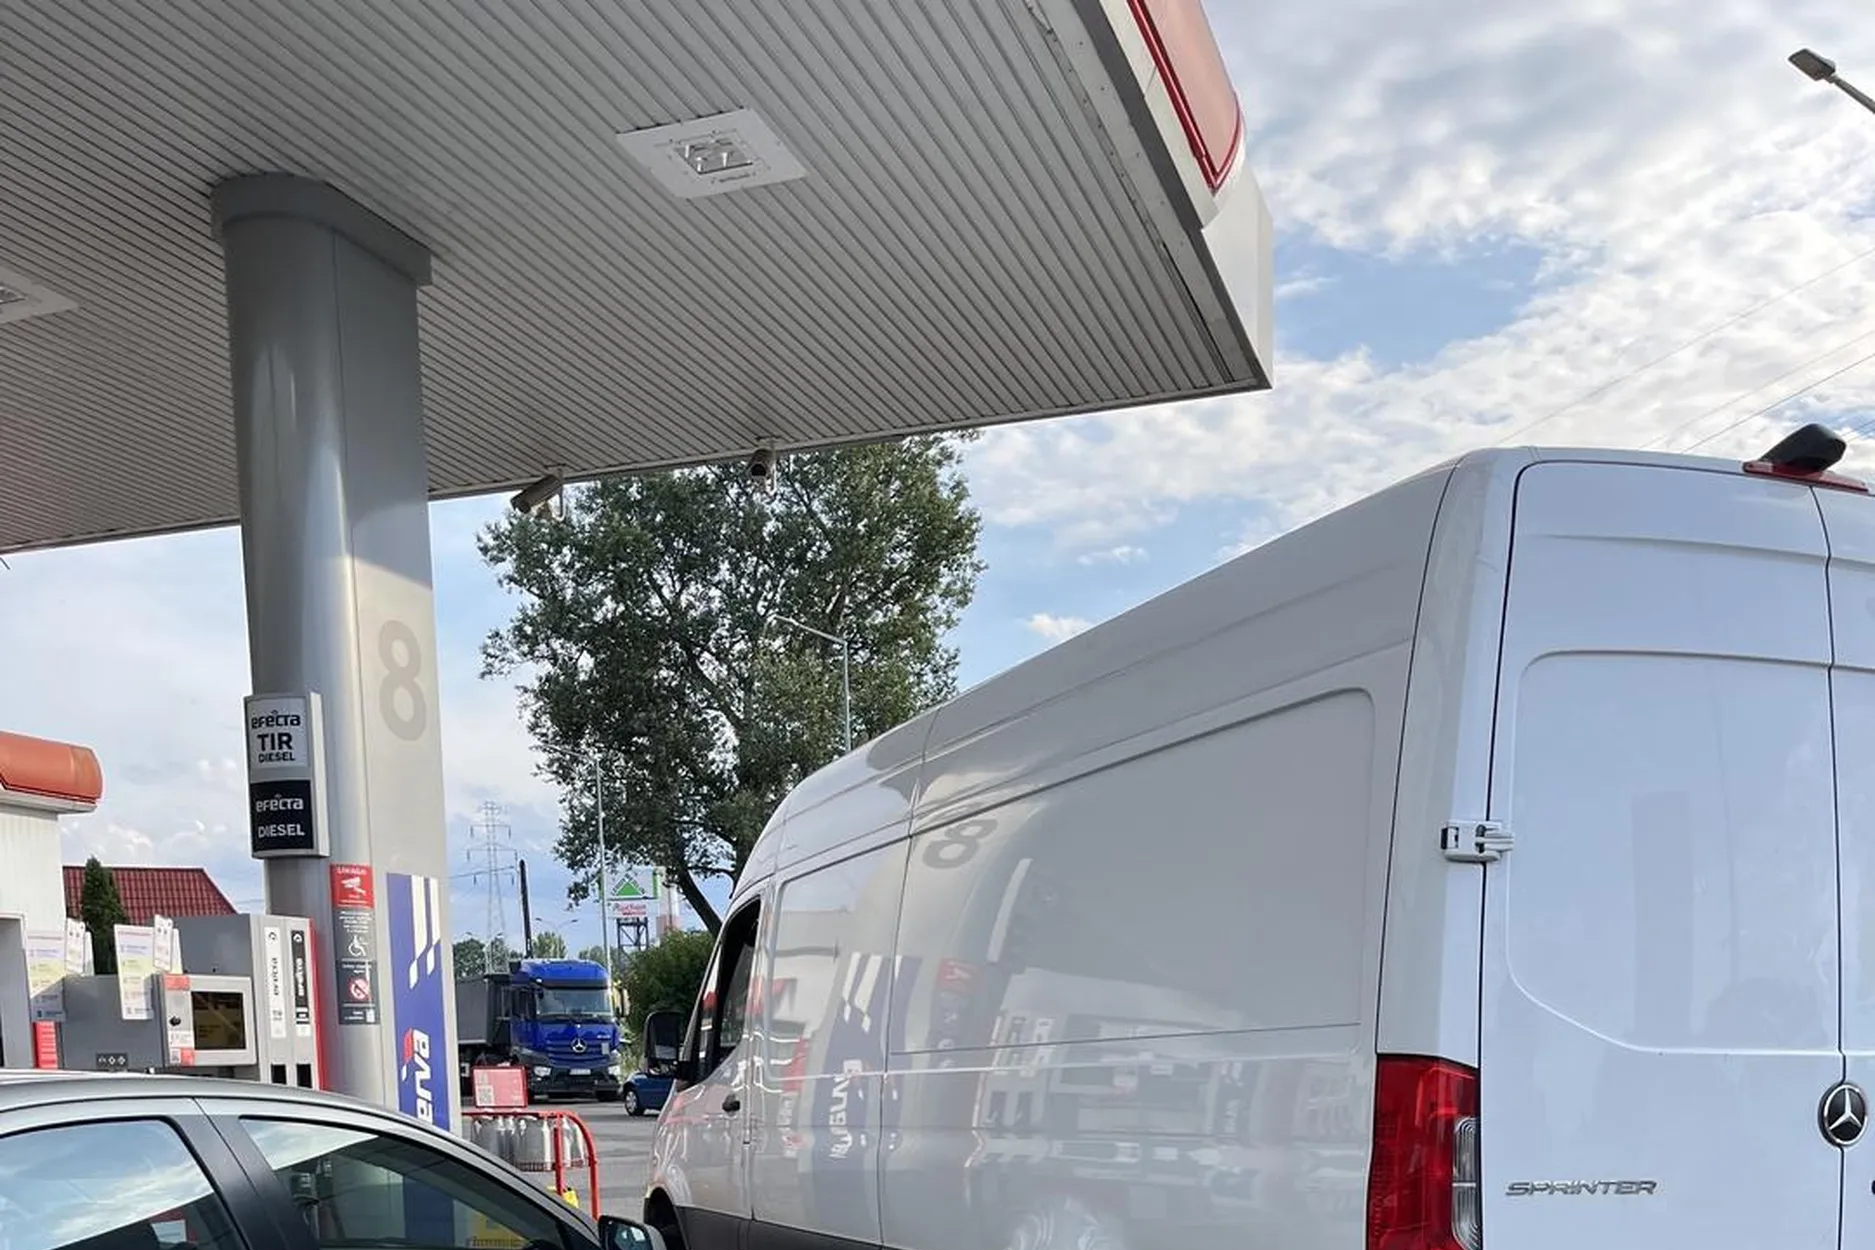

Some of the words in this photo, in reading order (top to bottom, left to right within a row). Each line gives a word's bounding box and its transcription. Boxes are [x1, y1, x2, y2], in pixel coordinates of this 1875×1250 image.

[378, 619, 427, 741] 8
[251, 712, 301, 729] efecta
[257, 732, 293, 751] TIR
[258, 751, 296, 763] DIESEL
[256, 797, 304, 813] efecta
[257, 823, 306, 838] DIESEL
[413, 1029, 434, 1126] erva
[1505, 1179, 1657, 1196] SPRINTER
